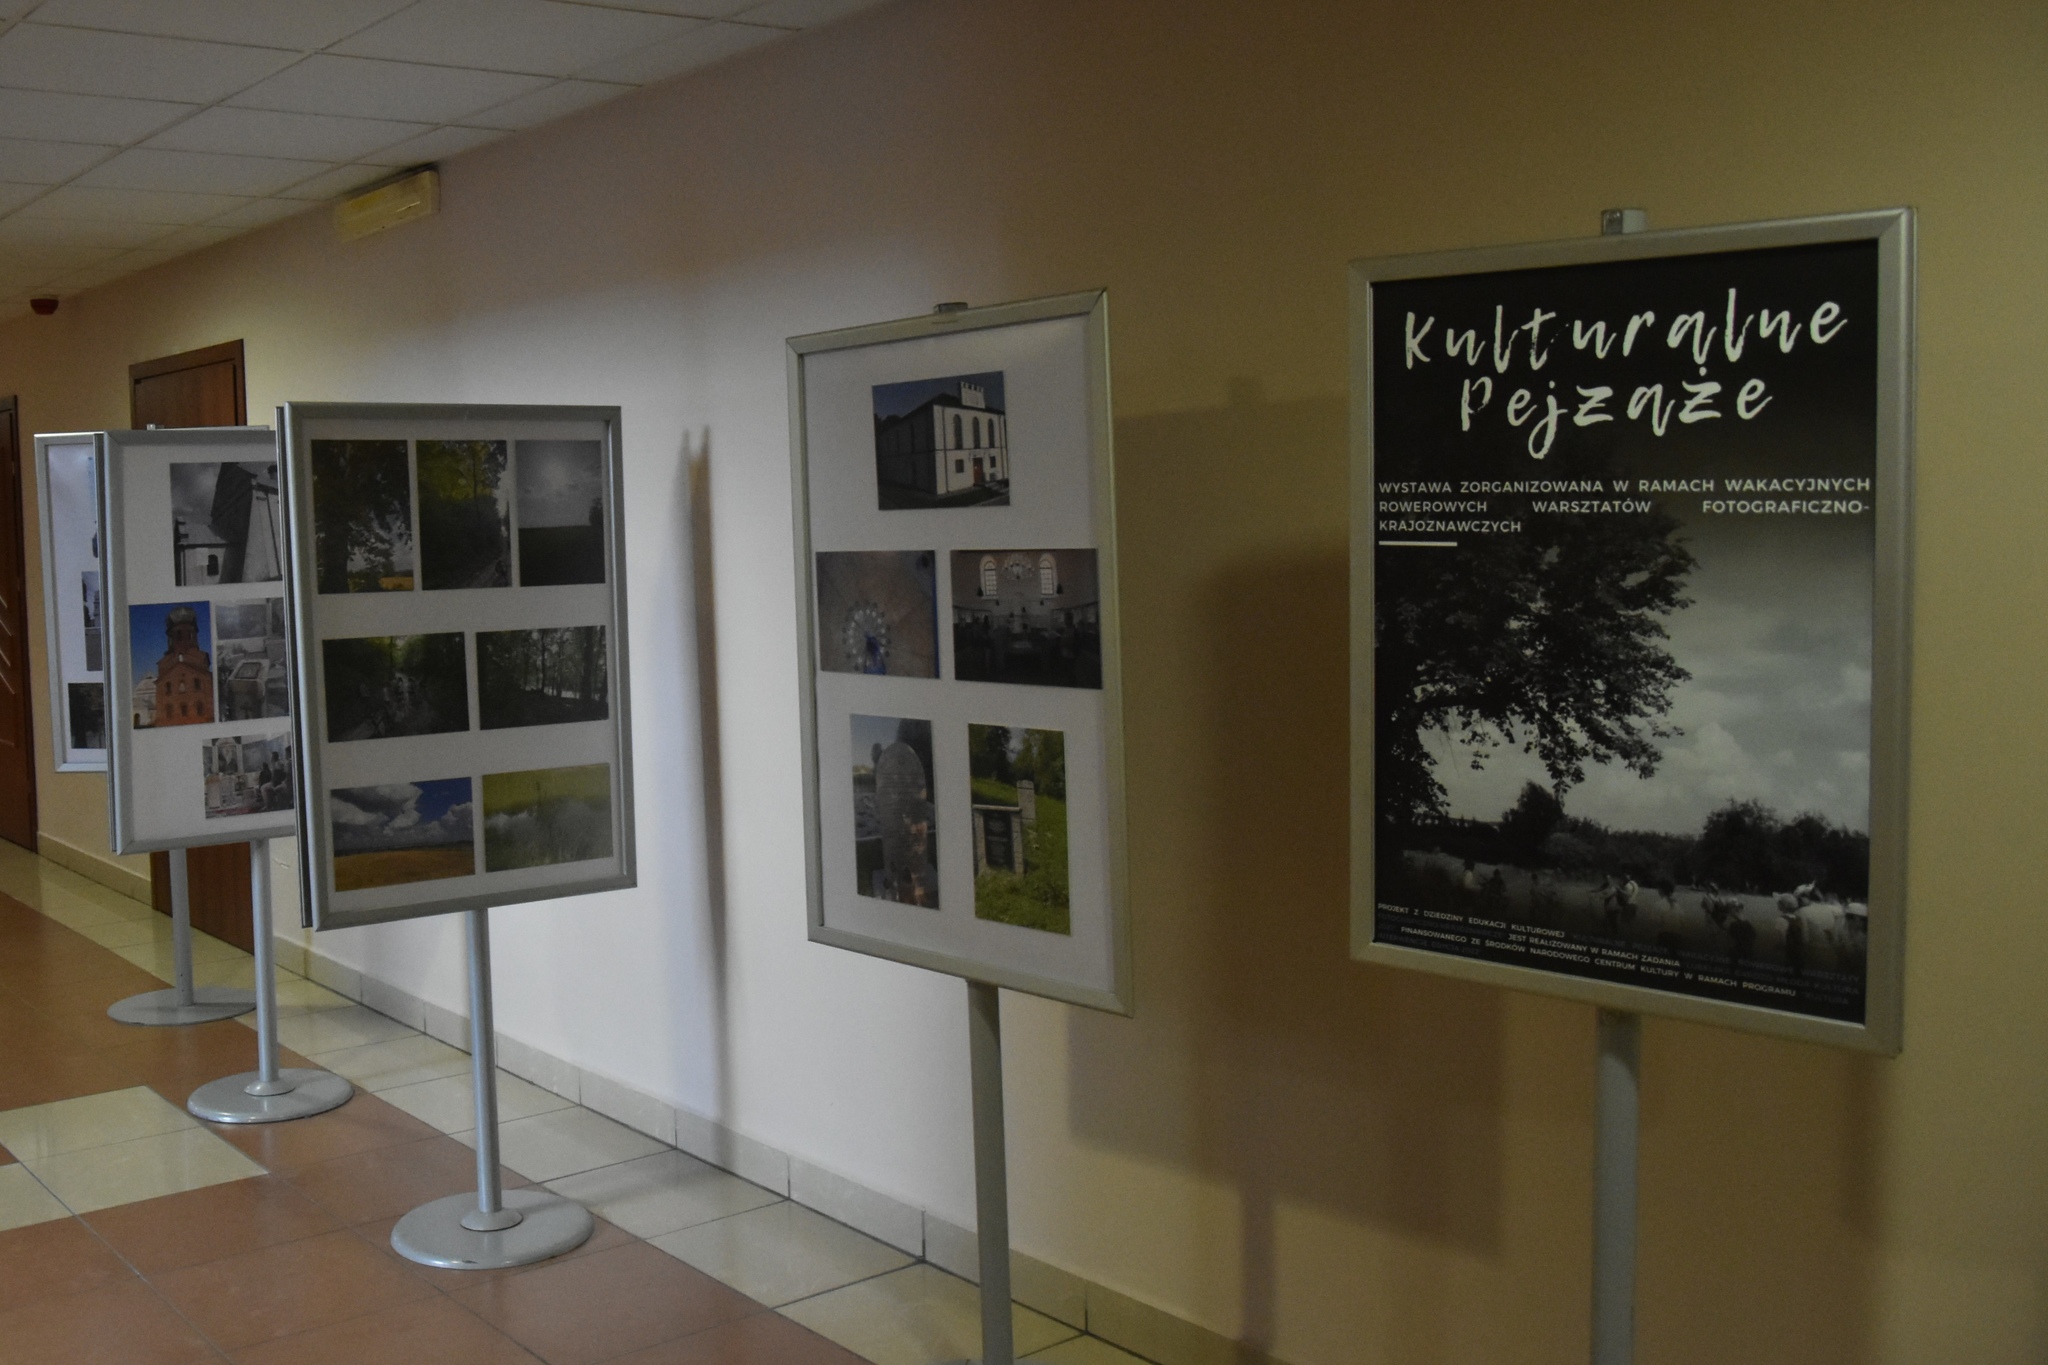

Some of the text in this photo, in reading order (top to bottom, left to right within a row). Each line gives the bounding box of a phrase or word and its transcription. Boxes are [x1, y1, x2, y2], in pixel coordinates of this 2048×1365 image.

[1404, 287, 1849, 374] Kulturalne
[1460, 366, 1774, 459] Pejzaże
[1378, 477, 1871, 494] WYSTAWA ZORGANIZOWANA W RAMACH WAKACYJNYCH
[1378, 498, 1870, 514] ROWEROWYCH WARSZTATÓW FOTOGRAFICZNO-
[1378, 520, 1522, 532] KRAJOZNAWCZYCH
[1377, 903, 1409, 914] PROJEKT
[1413, 908, 1420, 916] Z
[1423, 909, 1464, 922] DZIEDZINY
[1468, 916, 1507, 930] EDUKACJI
[1511, 923, 1565, 938] KULTUROWEJ
[1401, 927, 1467, 943] FINANSOWANEGO
[1471, 936, 1481, 946] ZE
[1485, 938, 1526, 953] ŚRODKÓW
[1529, 947, 1591, 964] NARODOWEGO
[1594, 957, 1636, 971] CENTRUM
[1640, 965, 1679, 978] KULTURY
[1684, 972, 1693, 981] W
[1698, 975, 1737, 987] RAMACH
[1742, 982, 1796, 996] PROGRAMU
[1508, 933, 1527, 943] JEST
[1529, 936, 1588, 953] REALIZOWANY
[1590, 946, 1599, 955] W
[1601, 948, 1639, 961] RAMACH
[1641, 954, 1681, 968] ZADANIA
